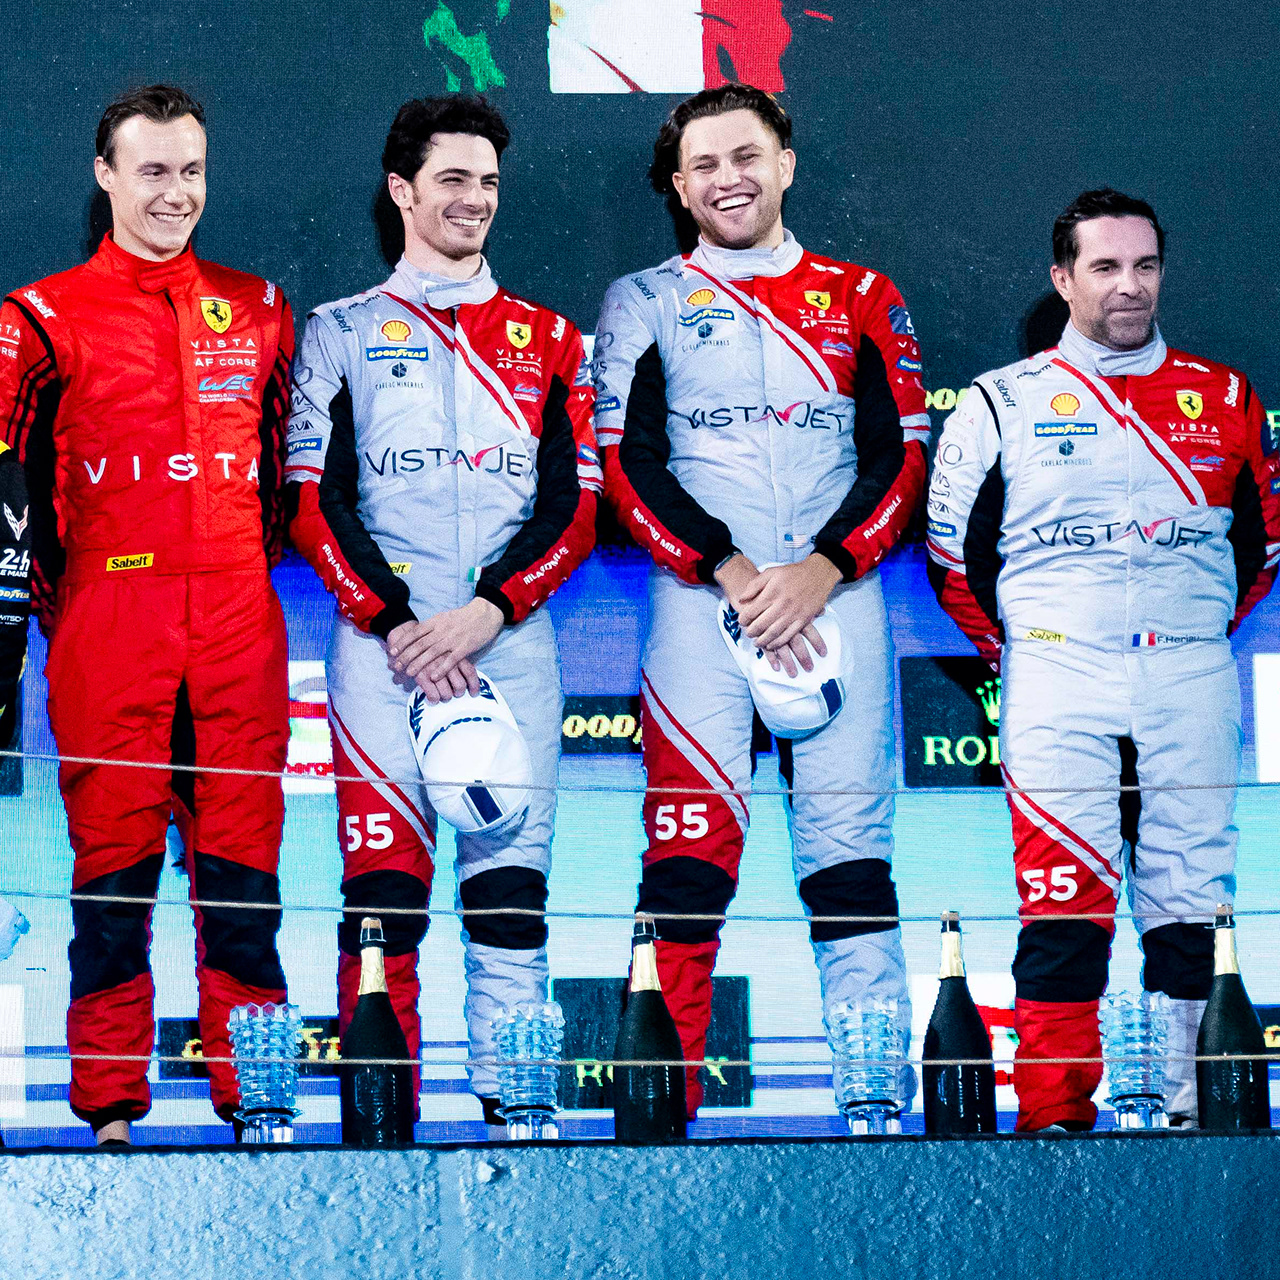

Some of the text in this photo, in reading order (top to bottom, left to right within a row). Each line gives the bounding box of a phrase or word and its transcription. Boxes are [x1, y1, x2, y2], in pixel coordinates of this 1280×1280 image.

[23, 290, 57, 319] Sabelt
[330, 307, 352, 333] Sabelt
[190, 338, 256, 348] VISTA
[368, 348, 427, 359] GOODYEAR
[195, 358, 257, 368] AF CORSE
[198, 375, 254, 391] WEC
[993, 378, 1016, 408] Sabelt
[1035, 424, 1096, 435] GOODYEAR
[1168, 422, 1220, 433] VISTA
[83, 452, 261, 485] VISTA
[1031, 518, 1213, 549] VISTAJET
[111, 556, 149, 569] Sabelt
[7, 570, 28, 578] MANS
[1027, 630, 1063, 643] Sabelt
[654, 803, 709, 842] 55
[346, 812, 395, 852] 55
[1022, 865, 1078, 903] 55
